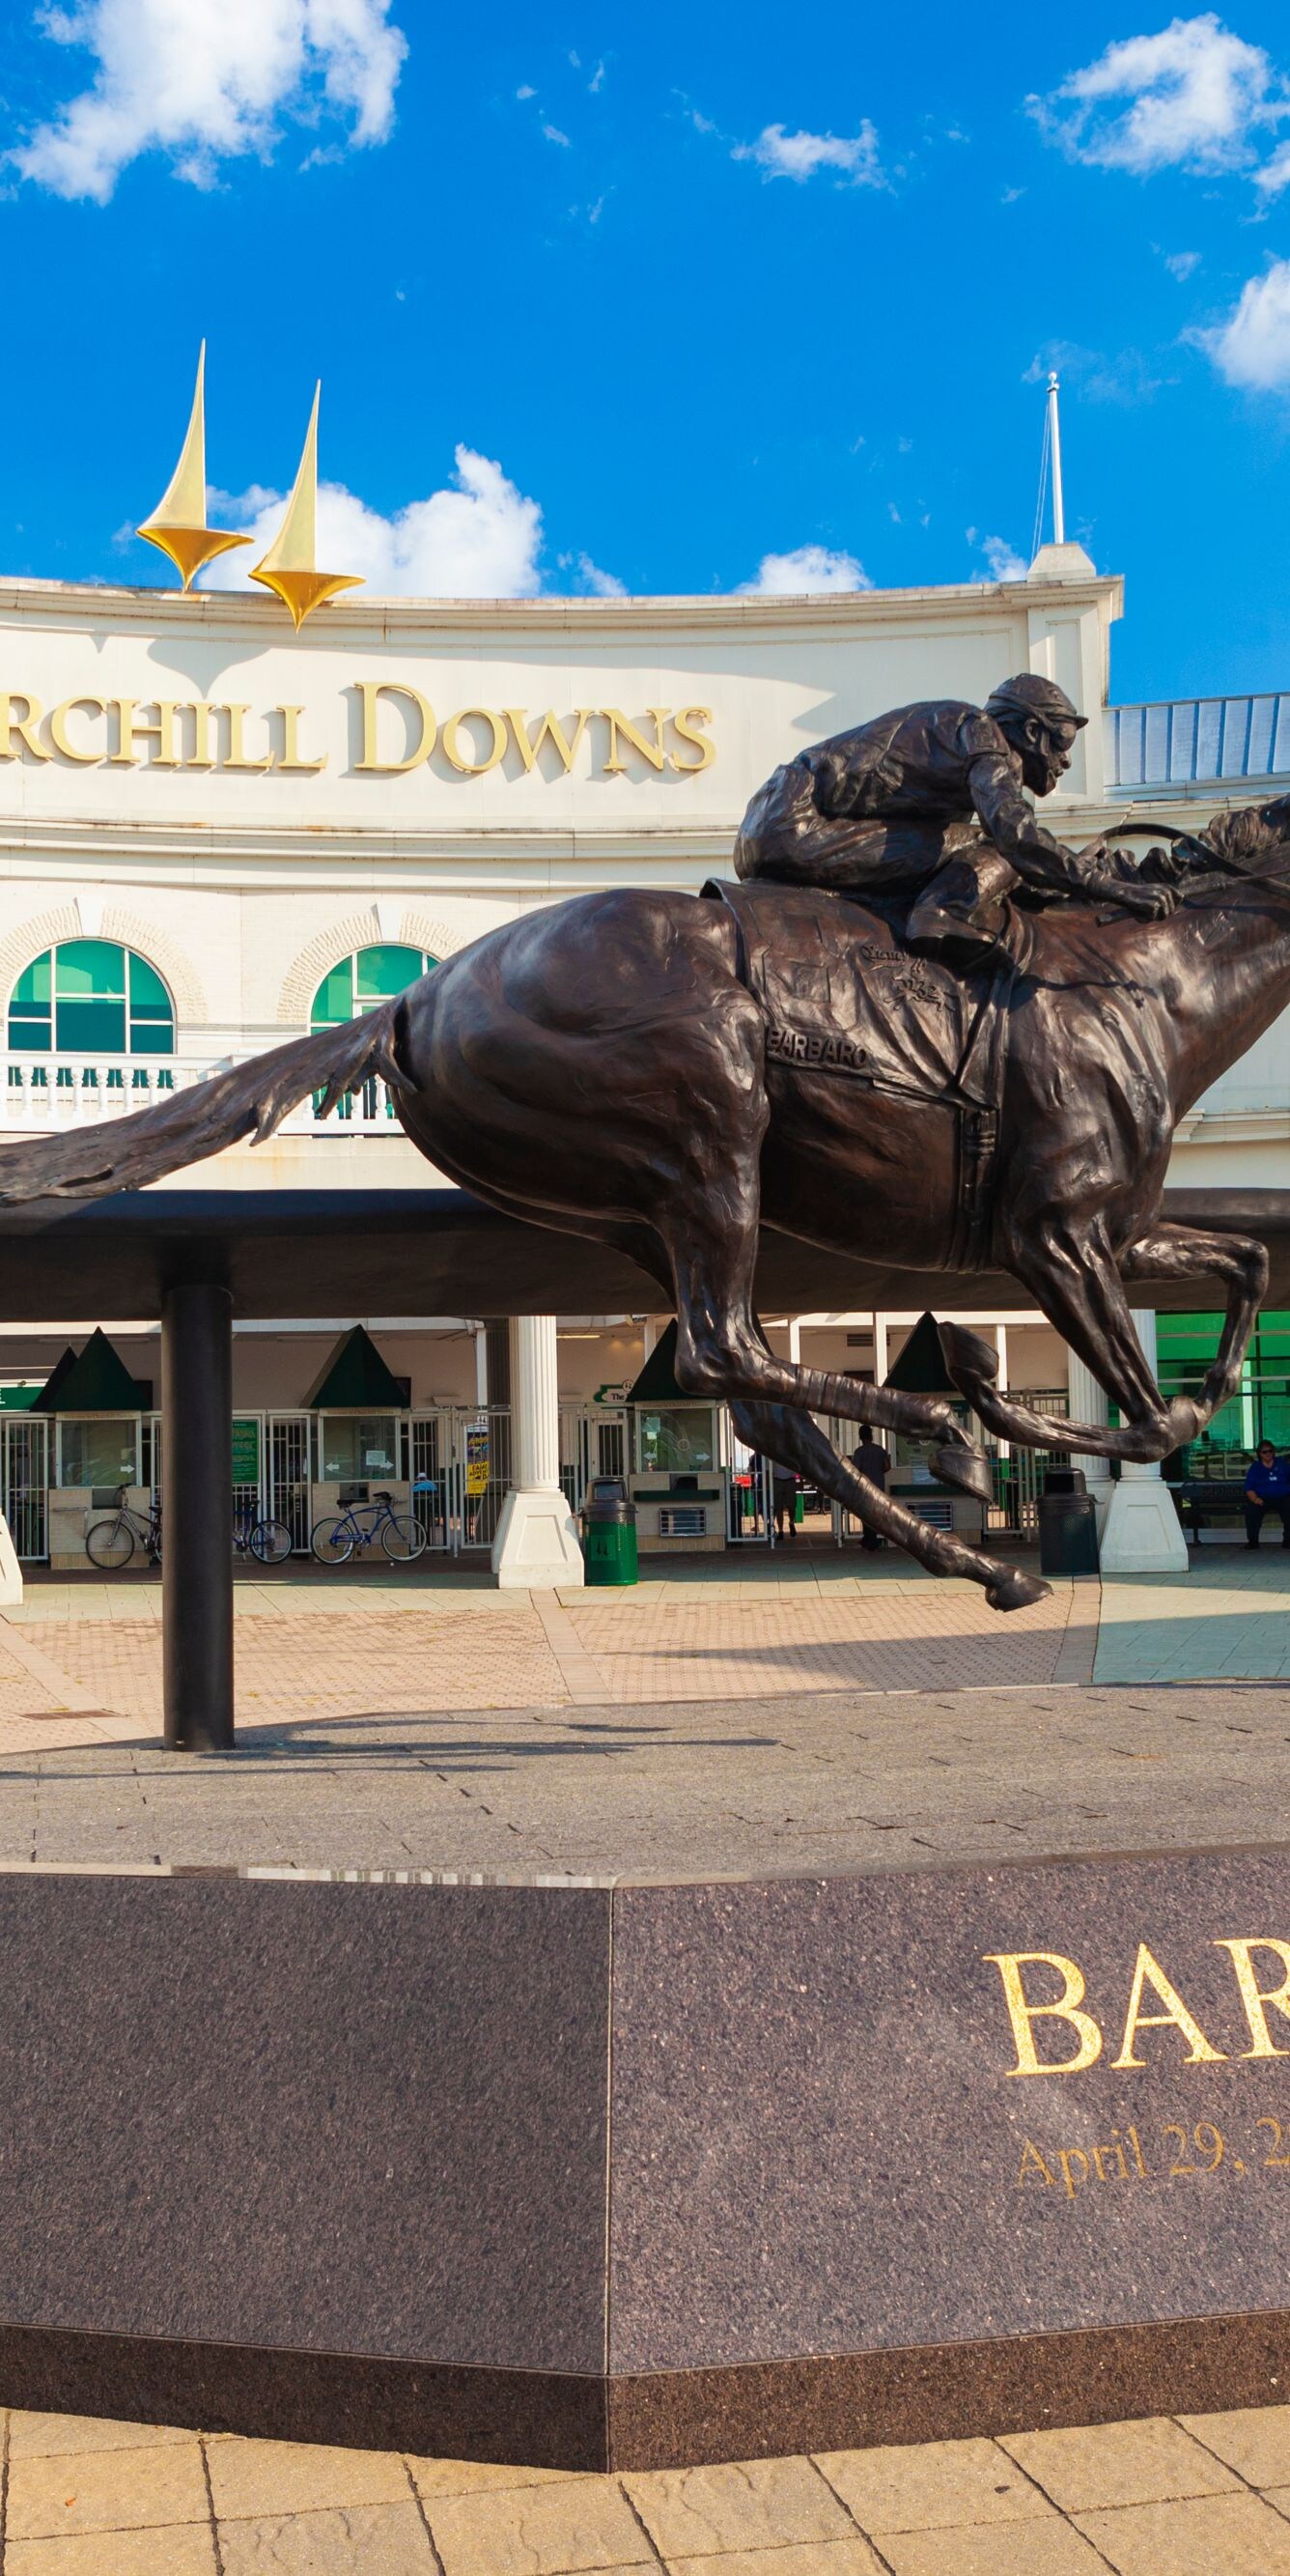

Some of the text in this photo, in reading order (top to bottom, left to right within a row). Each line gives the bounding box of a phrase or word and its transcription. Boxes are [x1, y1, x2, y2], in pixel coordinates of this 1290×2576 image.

[0, 681, 716, 774] RCHILL DOWNS
[767, 1026, 868, 1068] BARBARO
[982, 1937, 1290, 2077] BAR
[1018, 2116, 1290, 2199] April 29, 2
